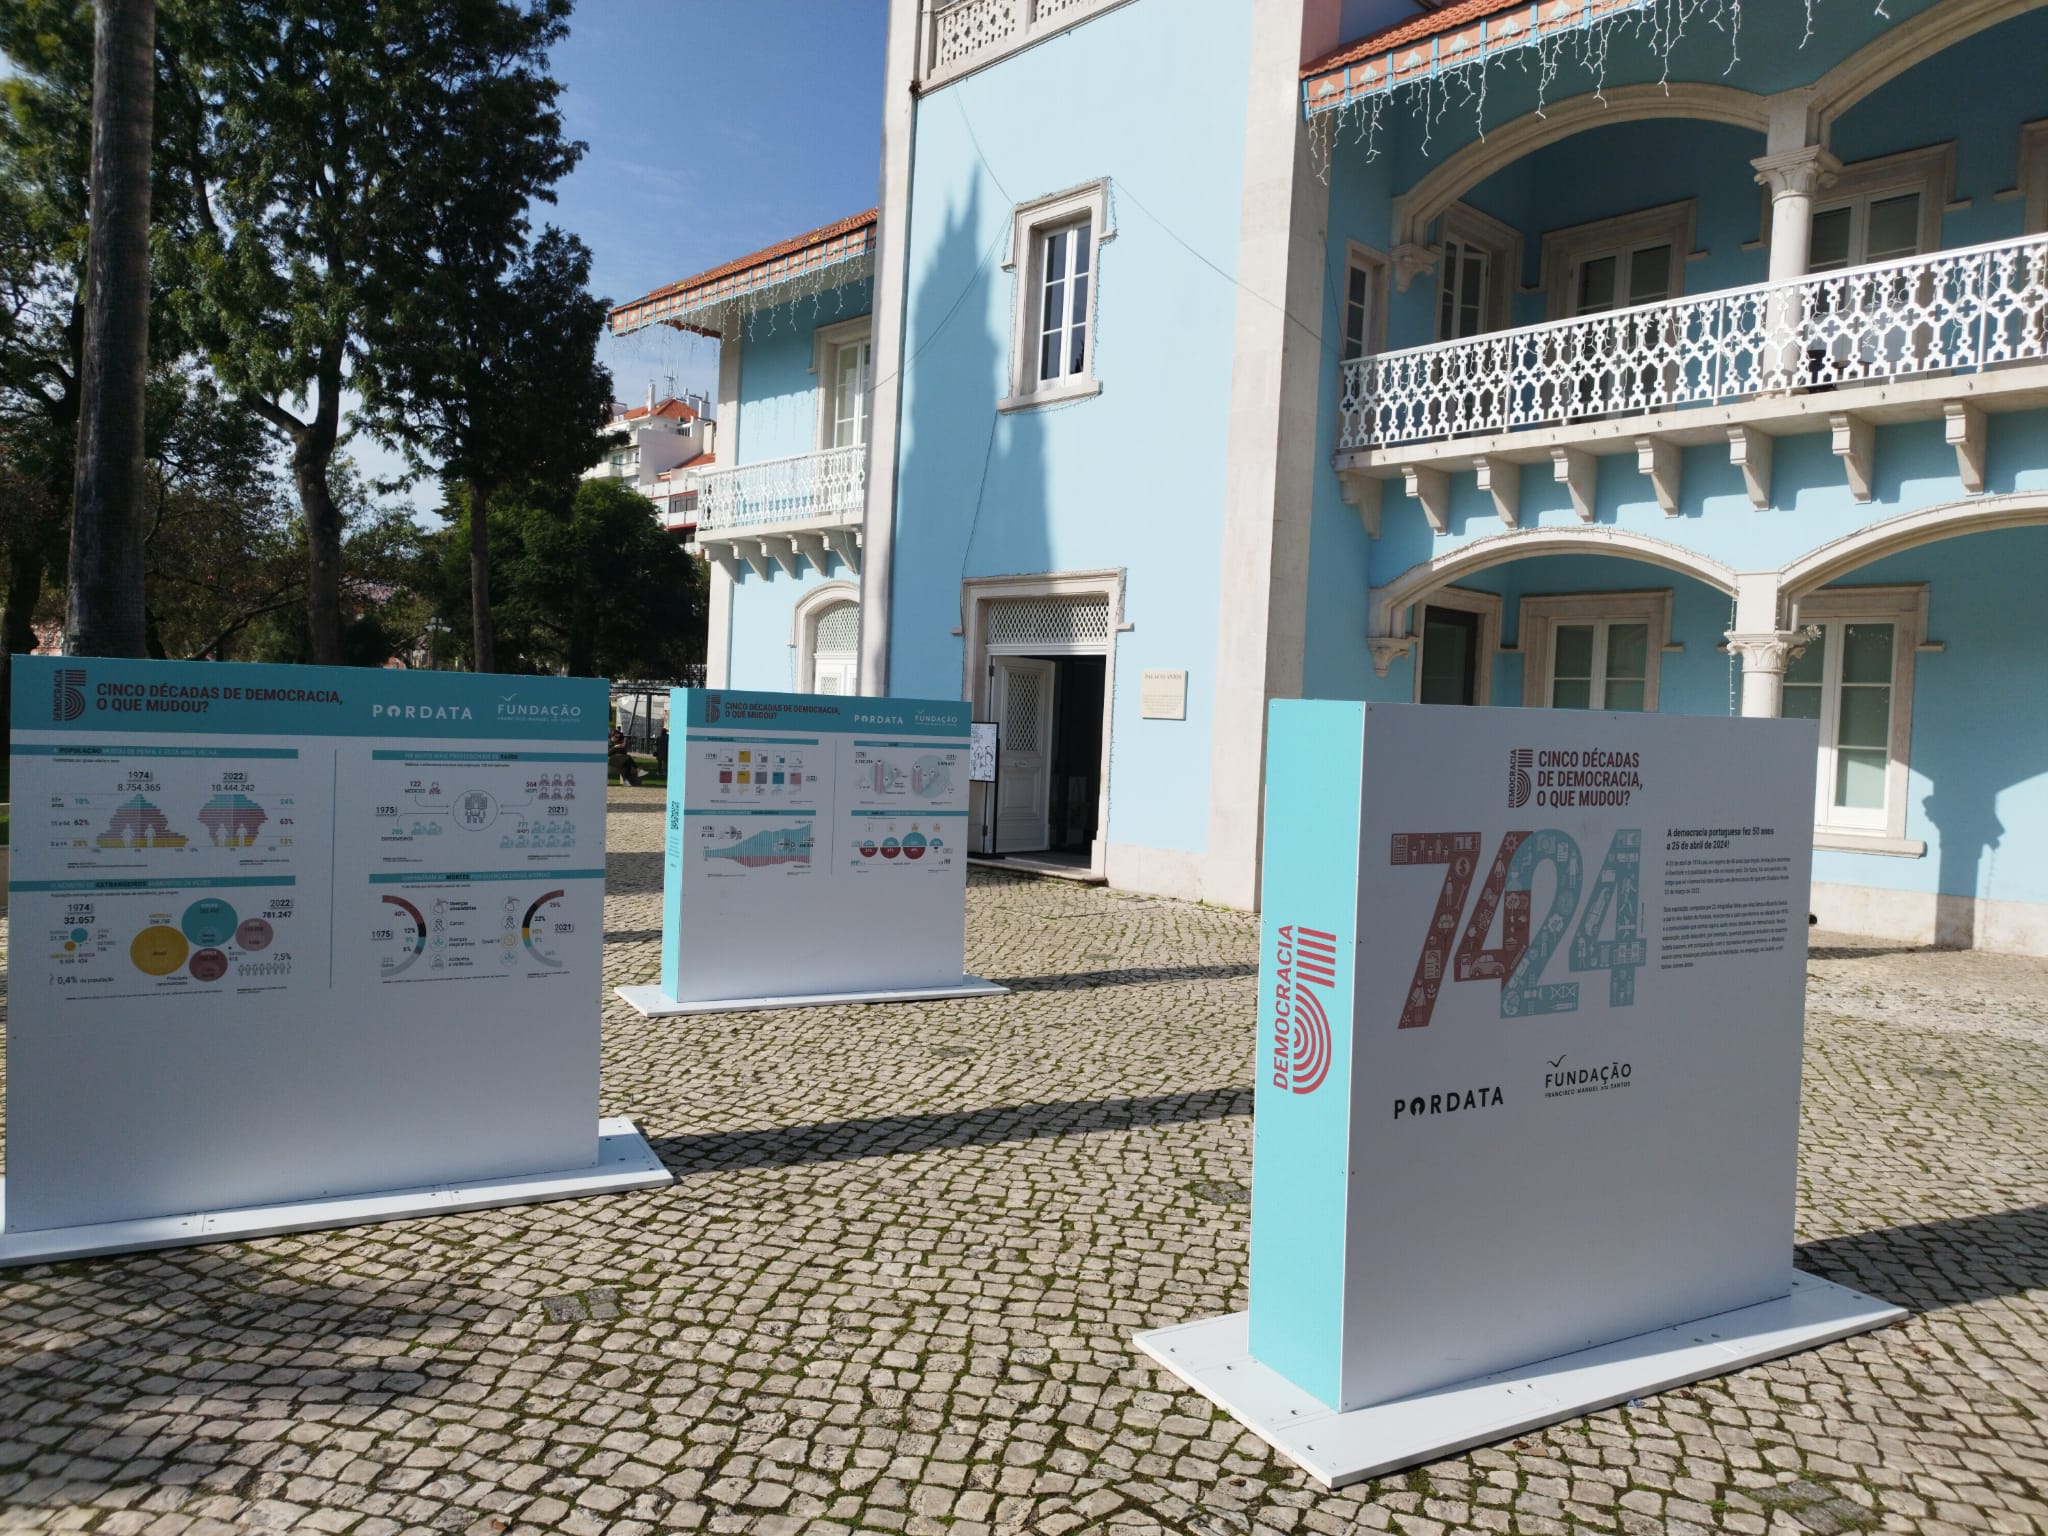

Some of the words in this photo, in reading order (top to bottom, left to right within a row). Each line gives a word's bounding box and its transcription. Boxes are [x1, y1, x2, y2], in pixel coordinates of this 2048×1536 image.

[96, 682, 146, 697] CINCO
[149, 682, 220, 699] DÉCADAS
[224, 687, 241, 701] DE
[244, 687, 343, 706] DEMOCRACIA,
[96, 697, 108, 711] O
[111, 698, 142, 712] QUE
[146, 699, 209, 713] MUDOU?
[497, 702, 581, 718] FUNDAÇÃO
[725, 701, 748, 711] CINCO
[372, 704, 473, 720] PORDATA
[854, 714, 904, 725] PORDATA
[1538, 750, 1579, 768] CINCO
[1582, 747, 1640, 769] DÉCADAS
[128, 771, 150, 779] 1974
[223, 772, 244, 780] 2022
[1507, 749, 1518, 808] DEMOCRACIA
[1537, 770, 1554, 787] DE
[1557, 770, 1643, 791] DEMOCRACIA,
[117, 783, 161, 792] 8.754.365
[211, 784, 256, 792] 10.444.242
[1536, 790, 1546, 807] O
[1549, 790, 1575, 808] QUE
[1578, 789, 1630, 807] MUDOU?
[376, 806, 395, 814] 1975
[1667, 828, 1673, 837] A
[1673, 827, 1708, 838] democracia
[1708, 827, 1741, 839] portuguesa
[1742, 826, 1752, 836] fez
[1752, 827, 1760, 836] 50
[1671, 841, 1680, 850] 25
[1680, 841, 1689, 850] de
[1689, 840, 1704, 849] abril
[1704, 840, 1712, 849] de
[1713, 839, 1730, 849] 2024!
[68, 903, 91, 911] 1974
[270, 899, 291, 907] 2022
[64, 915, 96, 925] 32.057
[262, 911, 293, 919] 781.247
[554, 923, 571, 931] 2021
[371, 930, 391, 939] 1975
[273, 952, 292, 961] 7,5%
[57, 976, 78, 985] 0,4%
[1272, 925, 1293, 1090] DEMOCRACIA
[1545, 1061, 1632, 1089] FUNDAÇÃO
[1544, 1088, 1575, 1098] FRANCISCO
[1577, 1085, 1599, 1094] MANUEL
[1610, 1080, 1631, 1089] SANTOS
[1394, 1086, 1504, 1119] PORDATA
